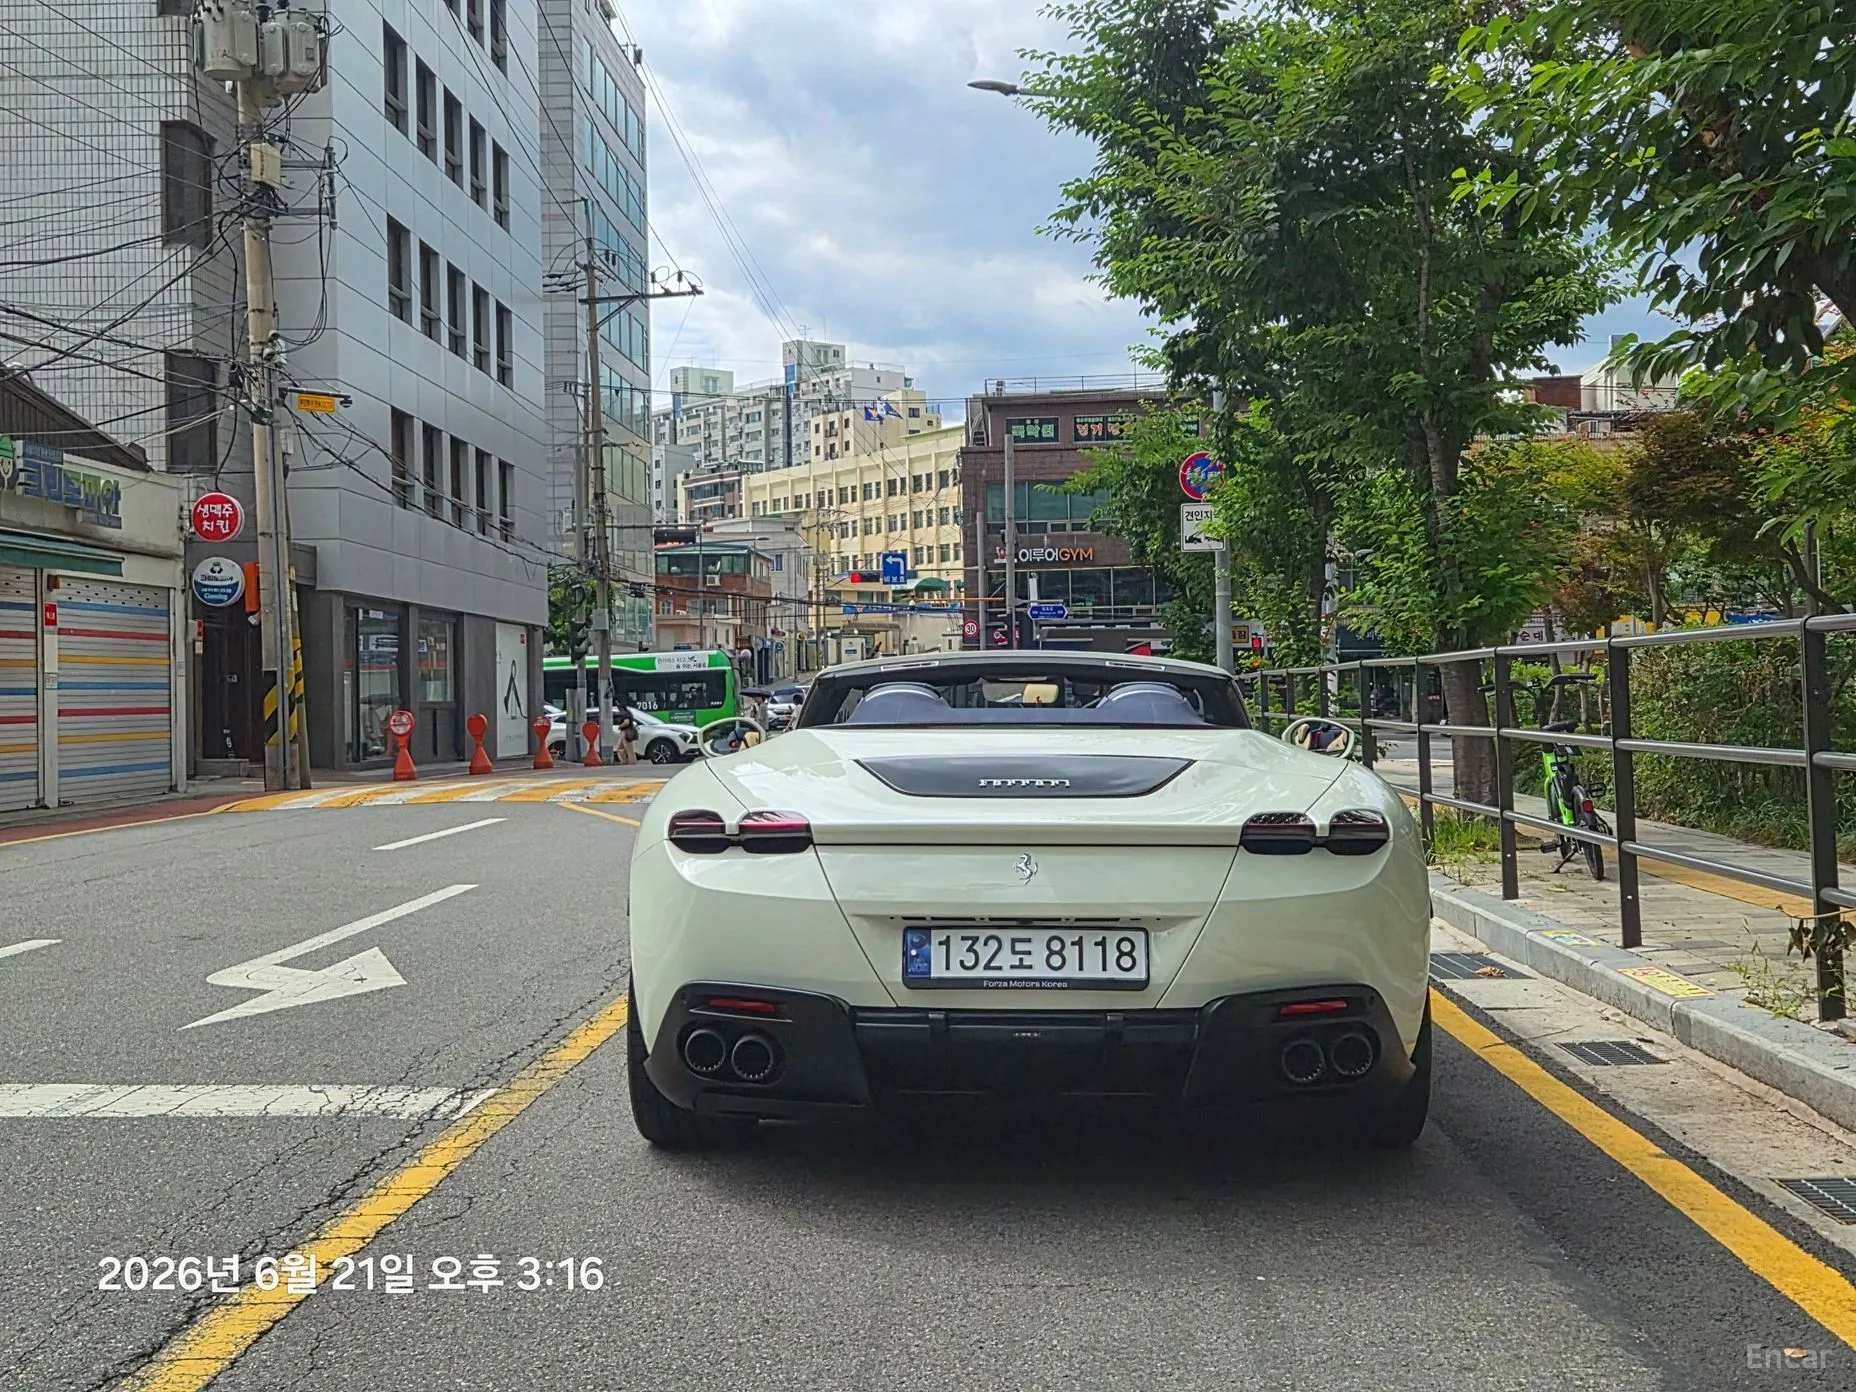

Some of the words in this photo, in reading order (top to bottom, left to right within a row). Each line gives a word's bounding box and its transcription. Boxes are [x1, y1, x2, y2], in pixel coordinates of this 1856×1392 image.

[197, 503, 234, 518] 생맥주
[202, 519, 230, 534] 치킨
[966, 624, 975, 633] 30
[636, 701, 659, 710] 7016
[937, 935, 1033, 971] 132도
[1045, 935, 1137, 972] 8118
[983, 980, 1008, 988] Forza
[1010, 980, 1040, 988] Motors
[1042, 980, 1068, 988] Korea
